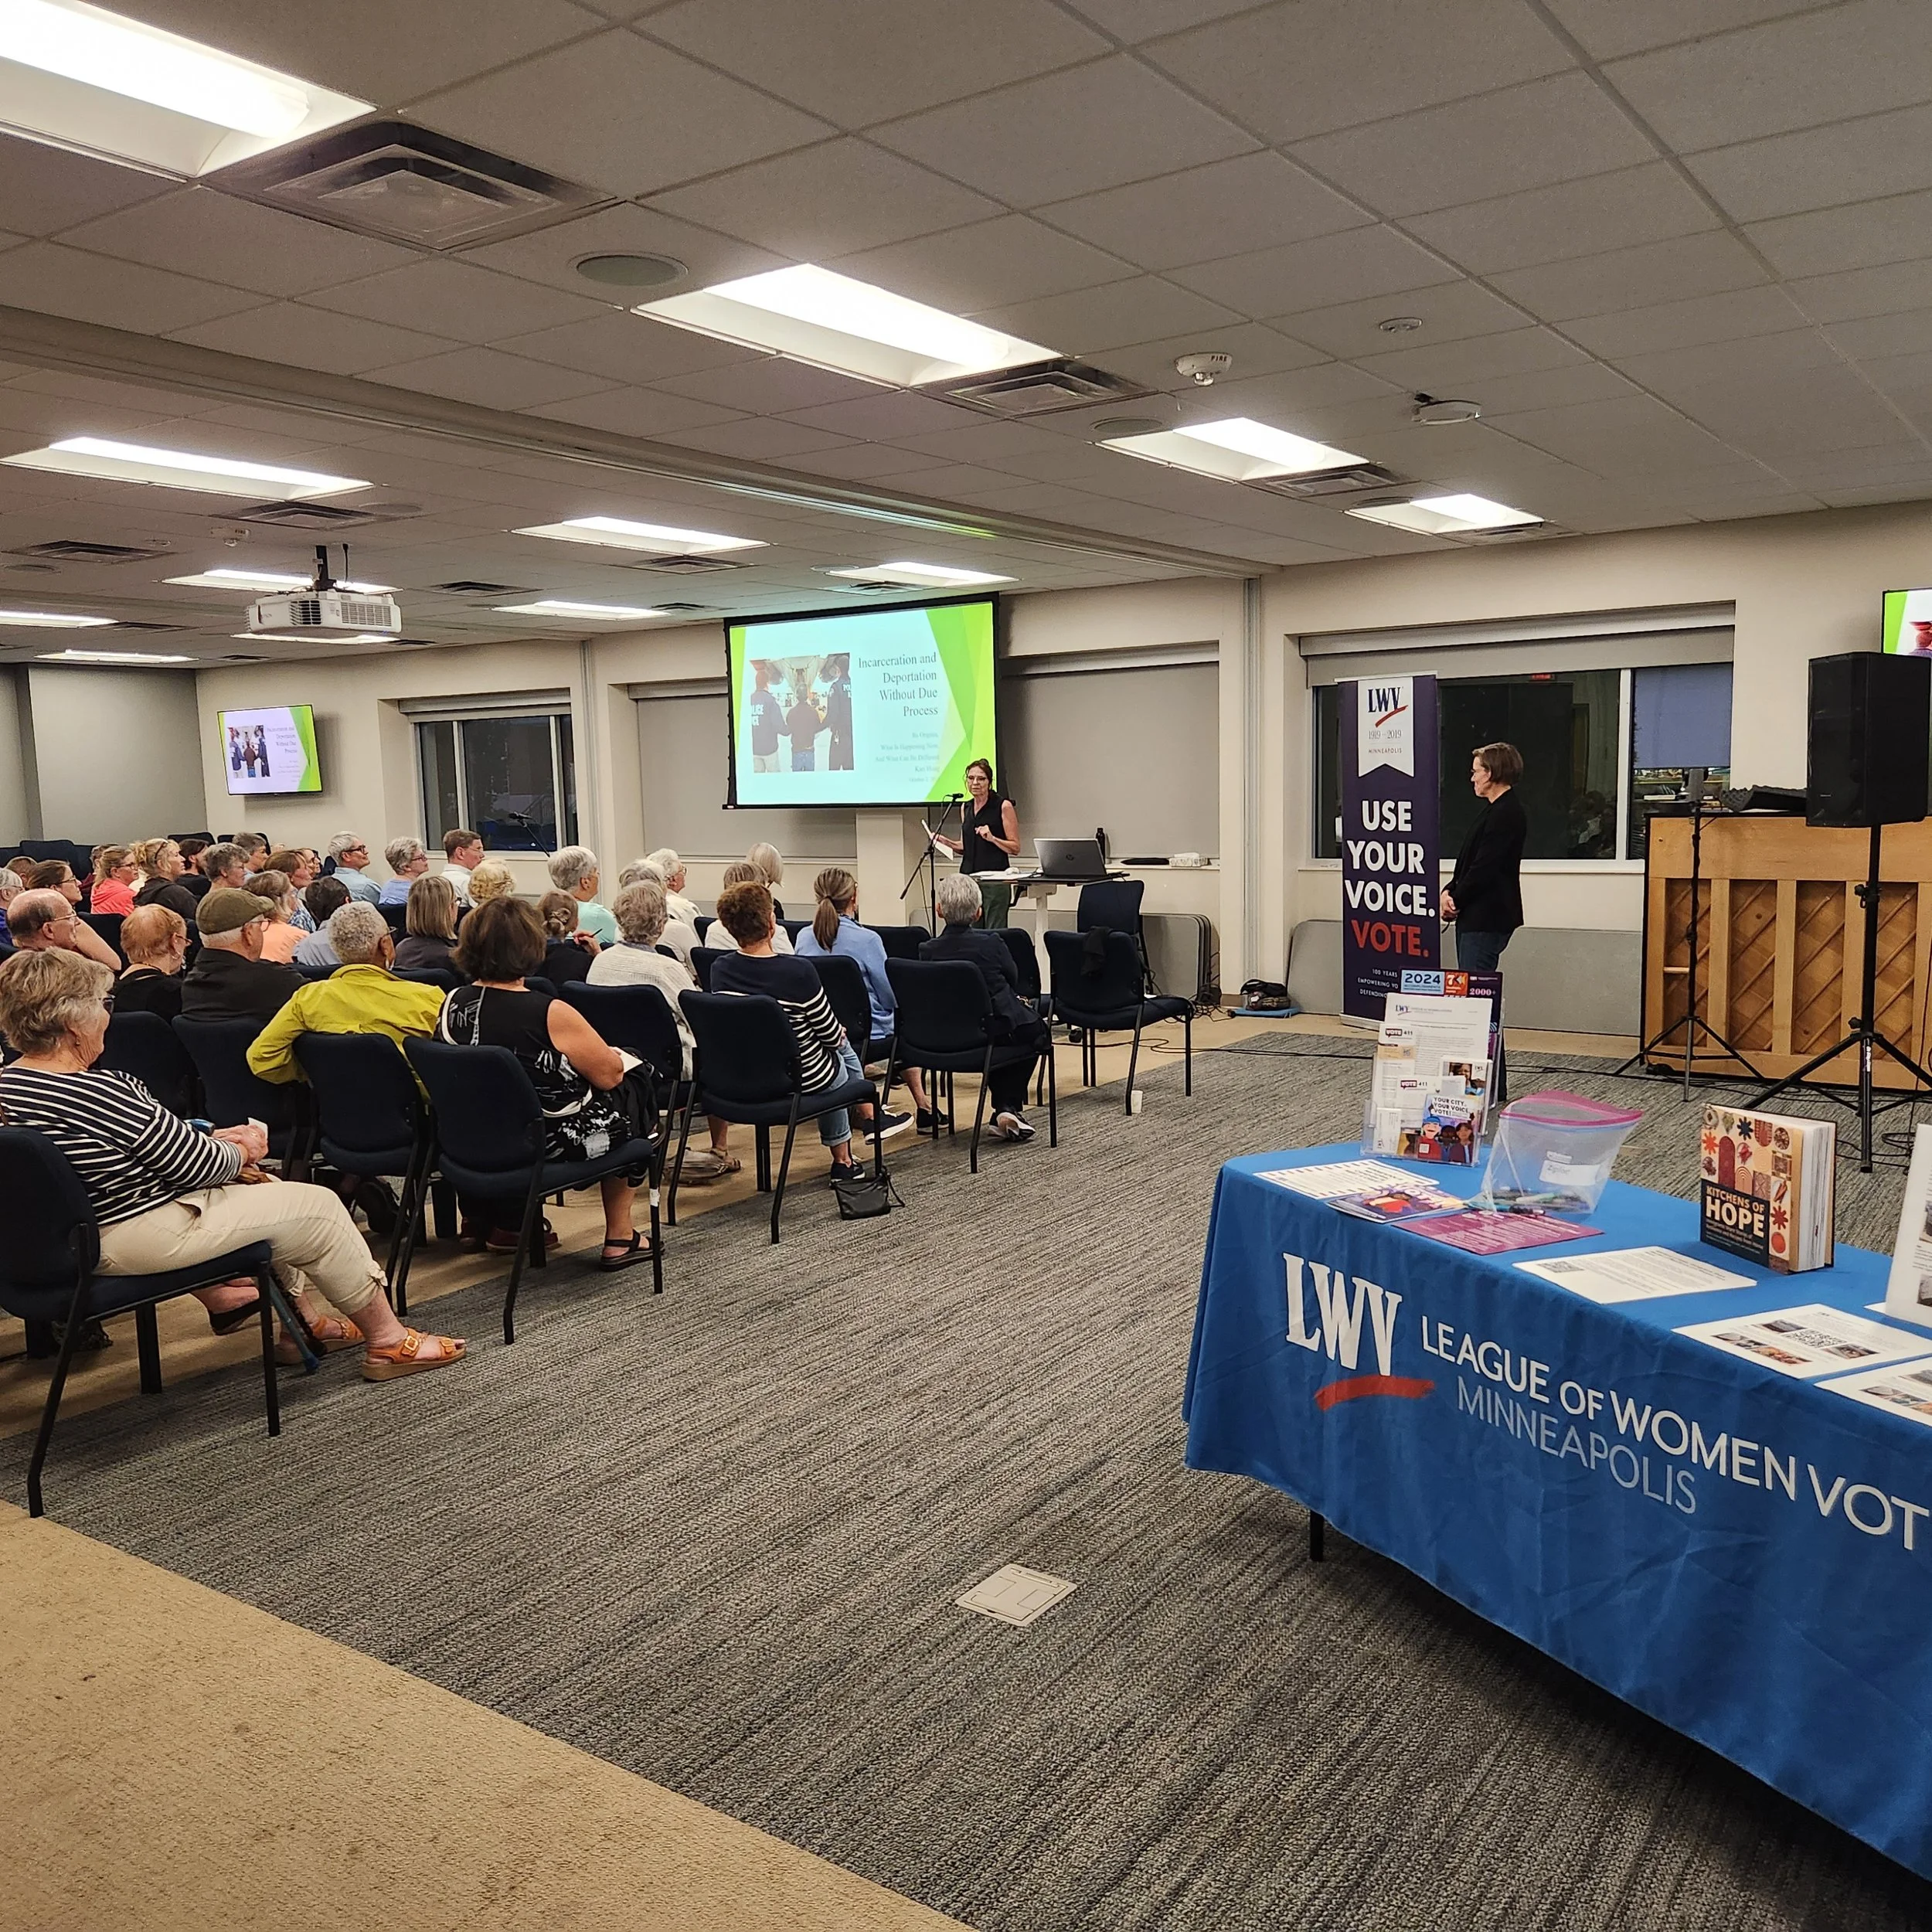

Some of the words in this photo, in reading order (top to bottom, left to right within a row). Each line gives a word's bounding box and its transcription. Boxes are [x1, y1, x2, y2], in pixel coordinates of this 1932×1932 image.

[859, 654, 917, 668] Incarceration
[920, 651, 937, 664] and
[883, 670, 937, 685] Deportation
[879, 689, 916, 701] Without
[918, 687, 937, 699] Due
[1368, 687, 1400, 713] LWV
[903, 706, 939, 716] Process
[1362, 800, 1412, 832] USE
[1347, 840, 1425, 874] YOUR
[1345, 879, 1436, 917] VOICE.
[1352, 920, 1429, 957] VOTE.
[1357, 977, 1390, 988] EMPOWERING
[1404, 973, 1440, 985] 2024
[1706, 1185, 1750, 1209] KITCHENS
[1752, 1202, 1764, 1213] OF
[1706, 1196, 1765, 1239] HOPE
[1282, 1252, 1403, 1376] LWV
[1422, 1315, 1549, 1404] LEAGUE
[1560, 1380, 1604, 1420] OF
[1610, 1389, 1796, 1502] WOMEN
[1807, 1464, 1930, 1551] VOT
[1458, 1375, 1696, 1515] MINNEAPOLIS
